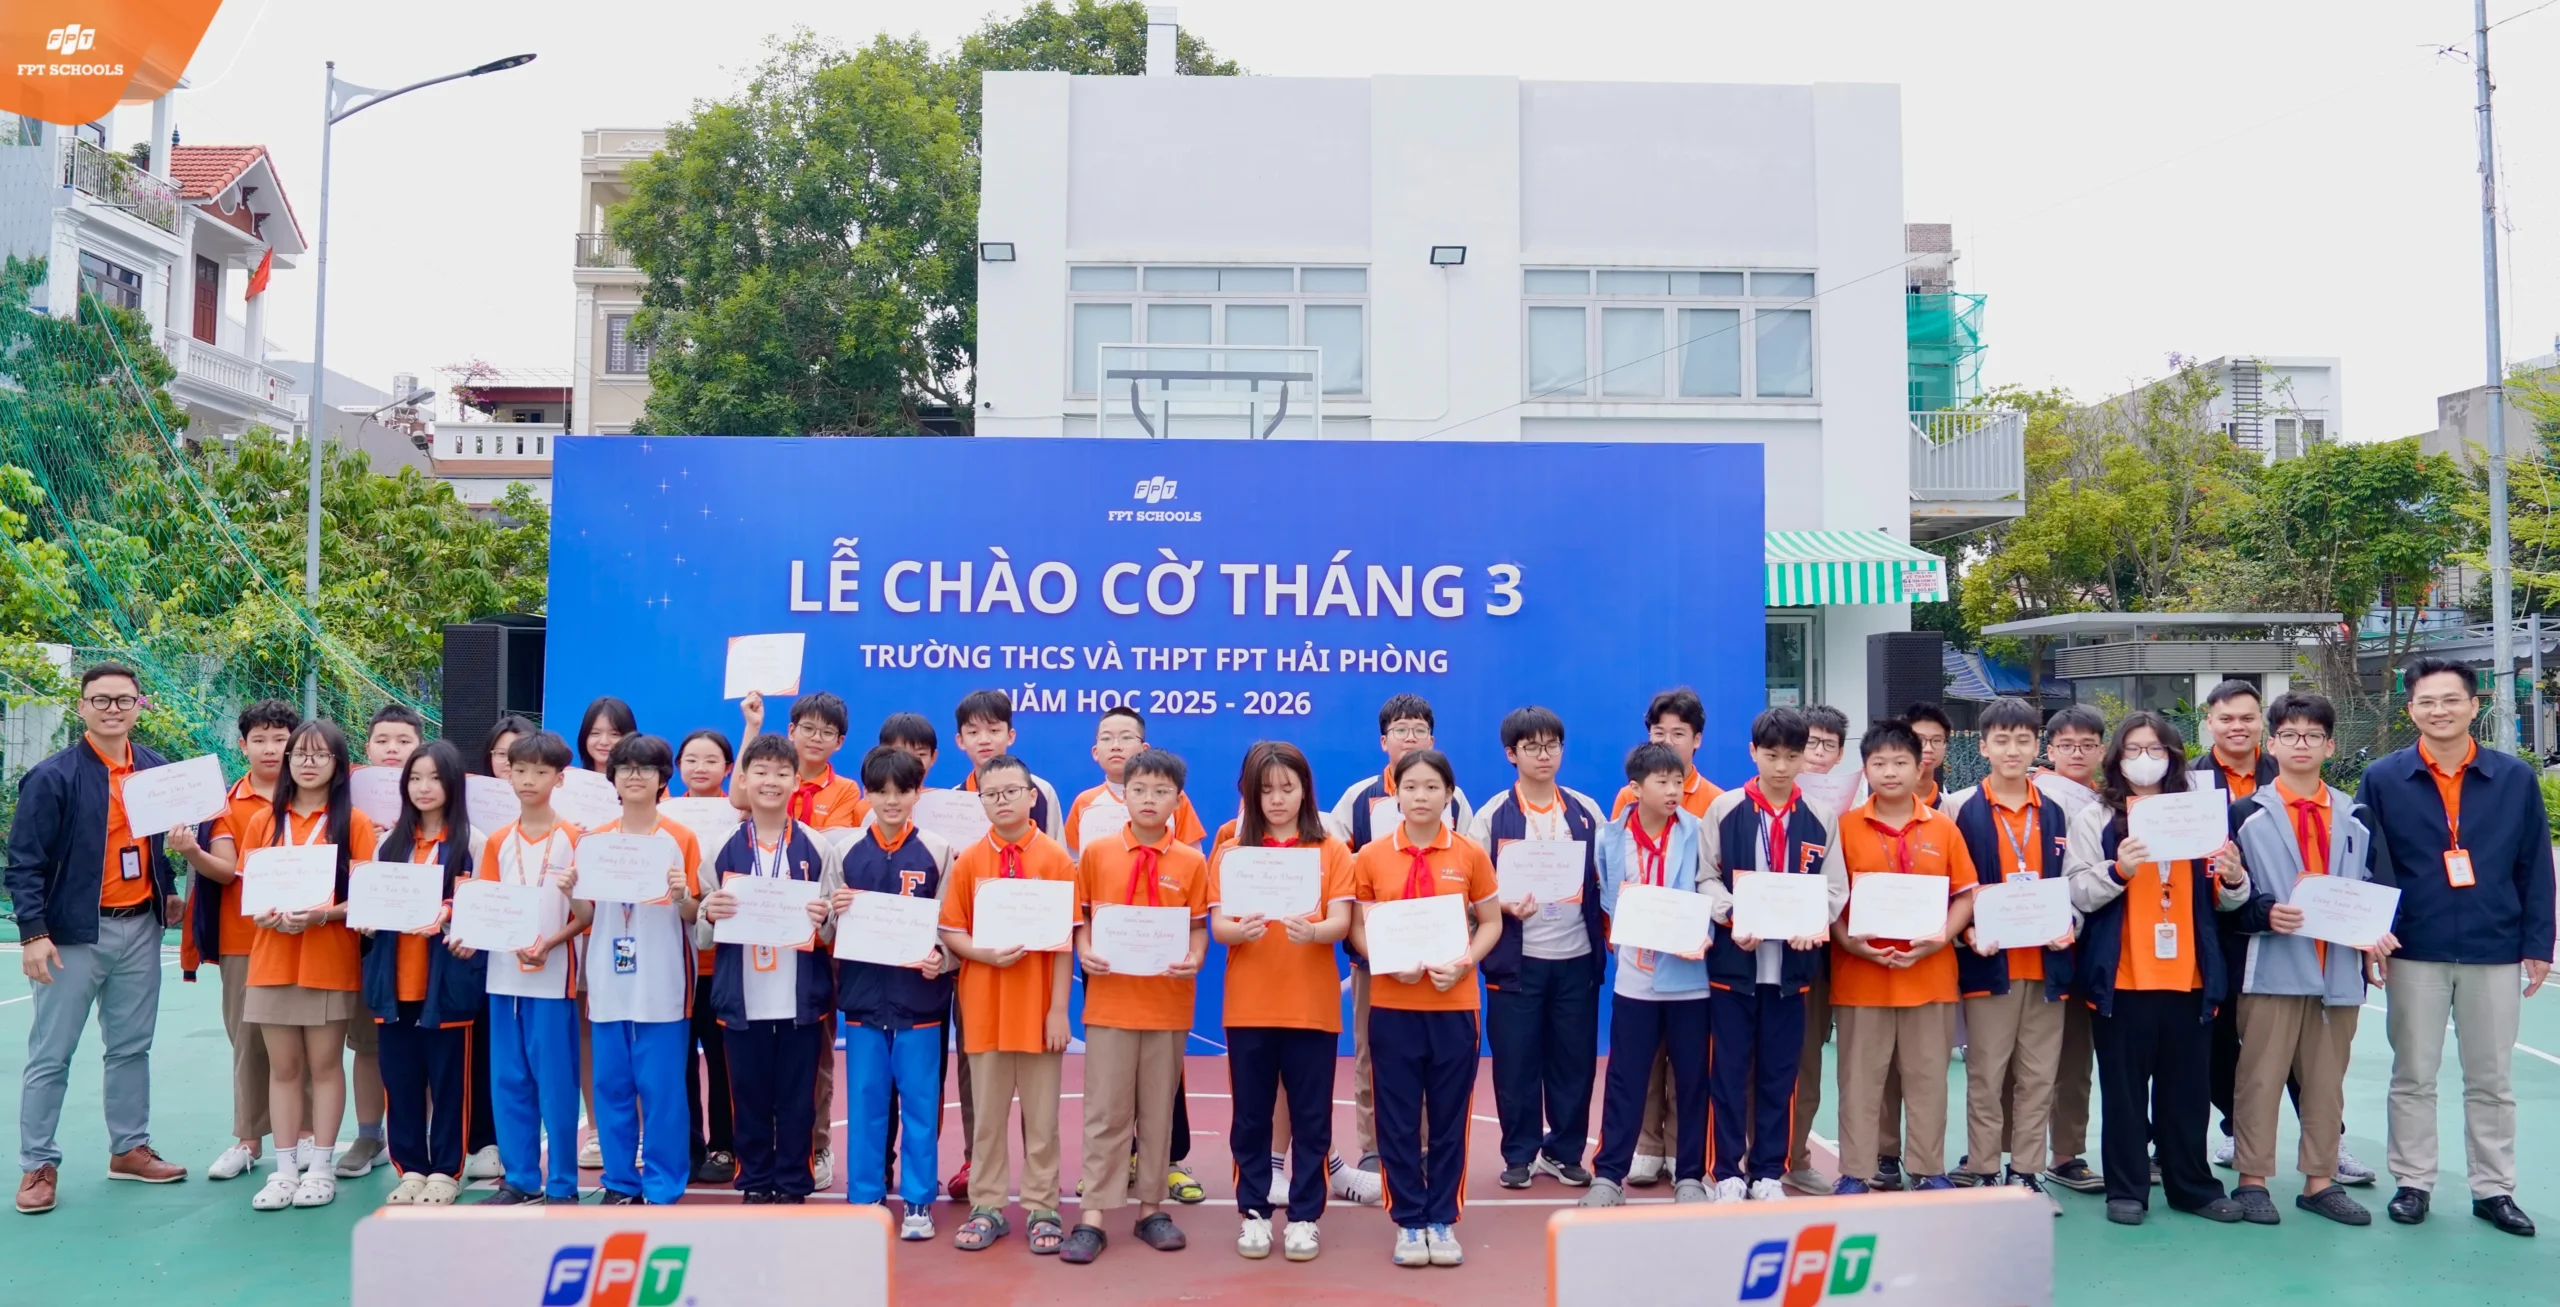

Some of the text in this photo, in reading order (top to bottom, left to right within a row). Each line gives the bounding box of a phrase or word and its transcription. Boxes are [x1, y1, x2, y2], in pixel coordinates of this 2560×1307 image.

[1108, 510, 1202, 522] FPT SCHOOLS
[790, 537, 1523, 617] LỄ CHÀO CỜ THÁNG 3
[860, 638, 1448, 673] TRƯỜNG THCS VÀ THPT FPT HẢI PHÒNG
[1149, 690, 1217, 714] 2025
[1243, 691, 1311, 715] 2026
[1800, 841, 1826, 874] F
[899, 870, 926, 897] F
